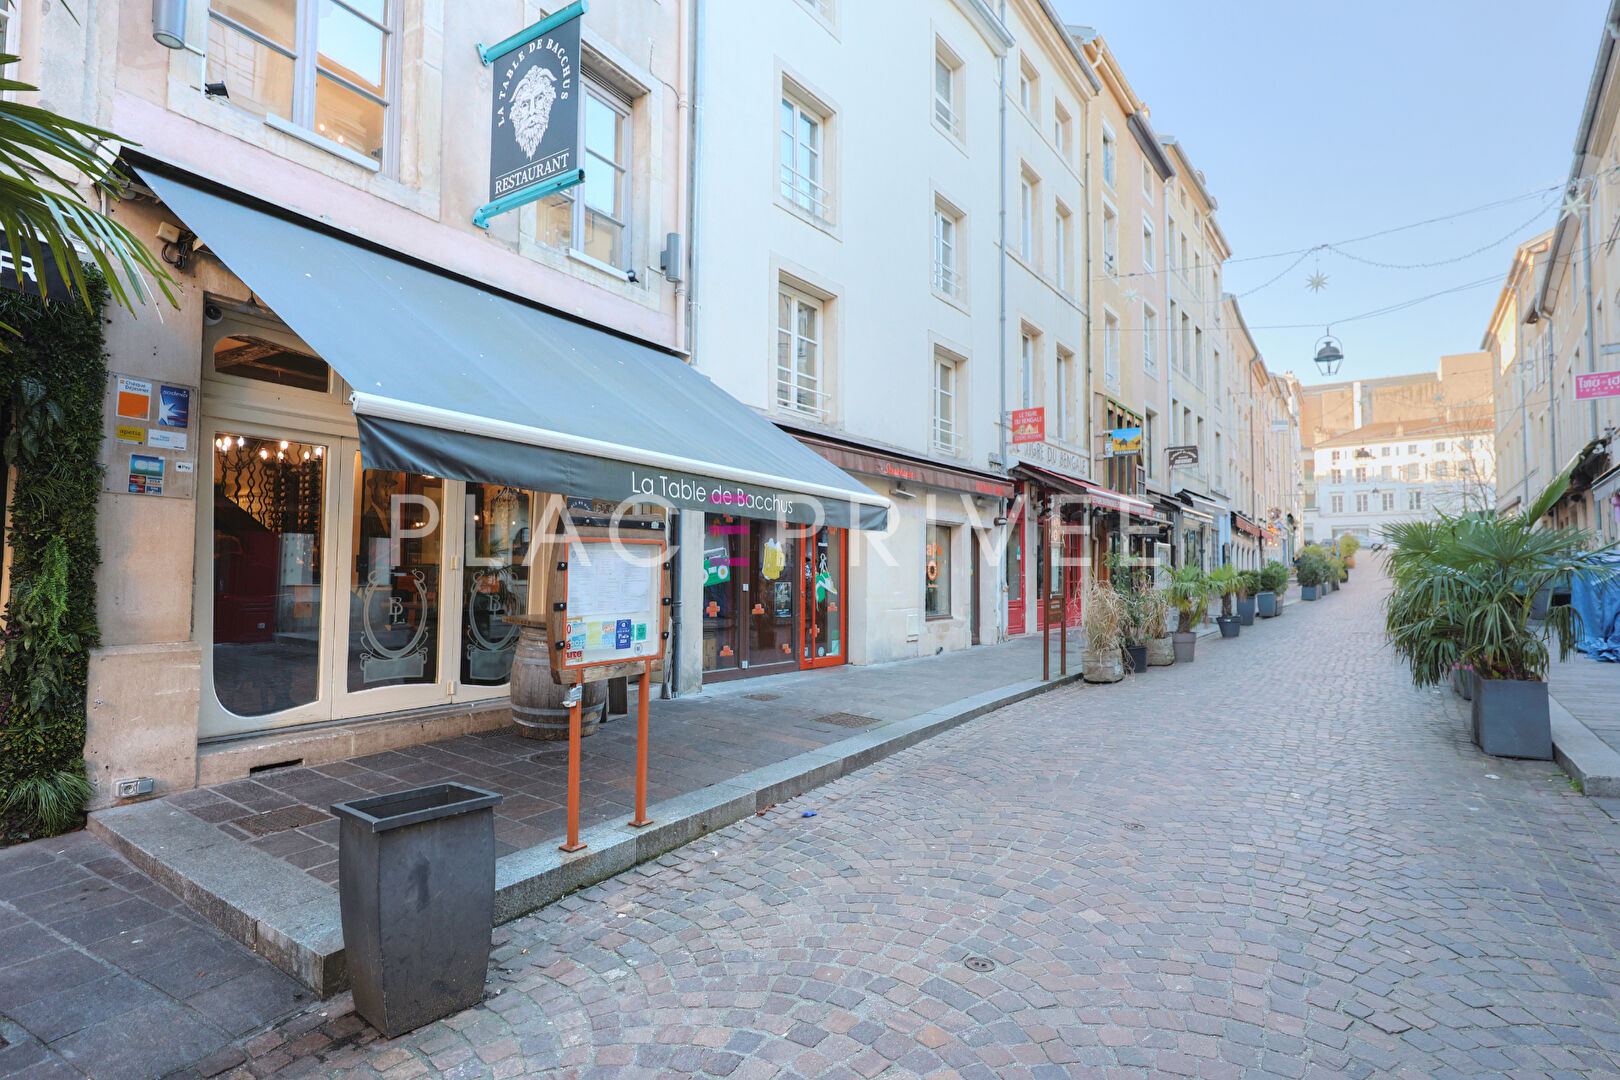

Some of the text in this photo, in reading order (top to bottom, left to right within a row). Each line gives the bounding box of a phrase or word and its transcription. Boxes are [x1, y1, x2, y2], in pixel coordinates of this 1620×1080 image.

[497, 37, 571, 127] LA TABLE DE BACCHUS
[495, 152, 570, 195] RESTAURANT
[1047, 446, 1057, 464] DU
[1060, 451, 1086, 475] BENGALE
[631, 471, 793, 515] La Table de Bacchus
